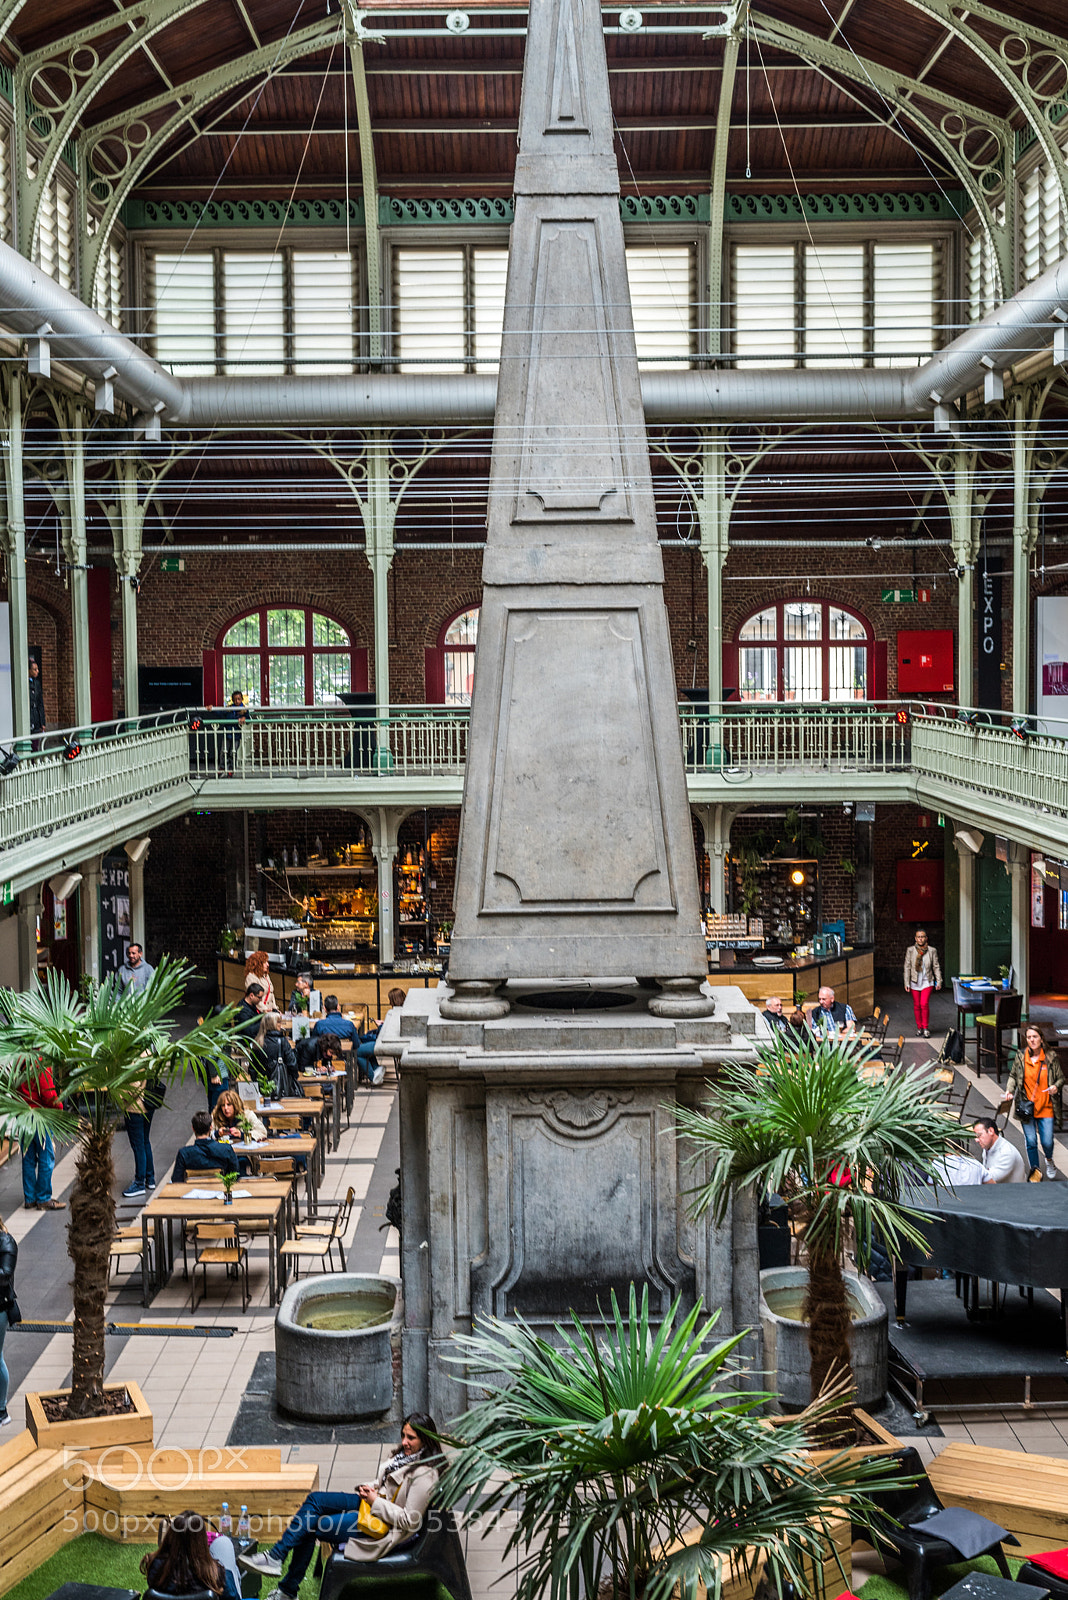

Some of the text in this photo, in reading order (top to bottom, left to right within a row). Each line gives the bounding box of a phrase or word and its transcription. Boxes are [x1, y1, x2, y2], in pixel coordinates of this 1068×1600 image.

[983, 577, 994, 654] EXPO
[101, 868, 130, 887] EXPO
[102, 896, 116, 914] +1
